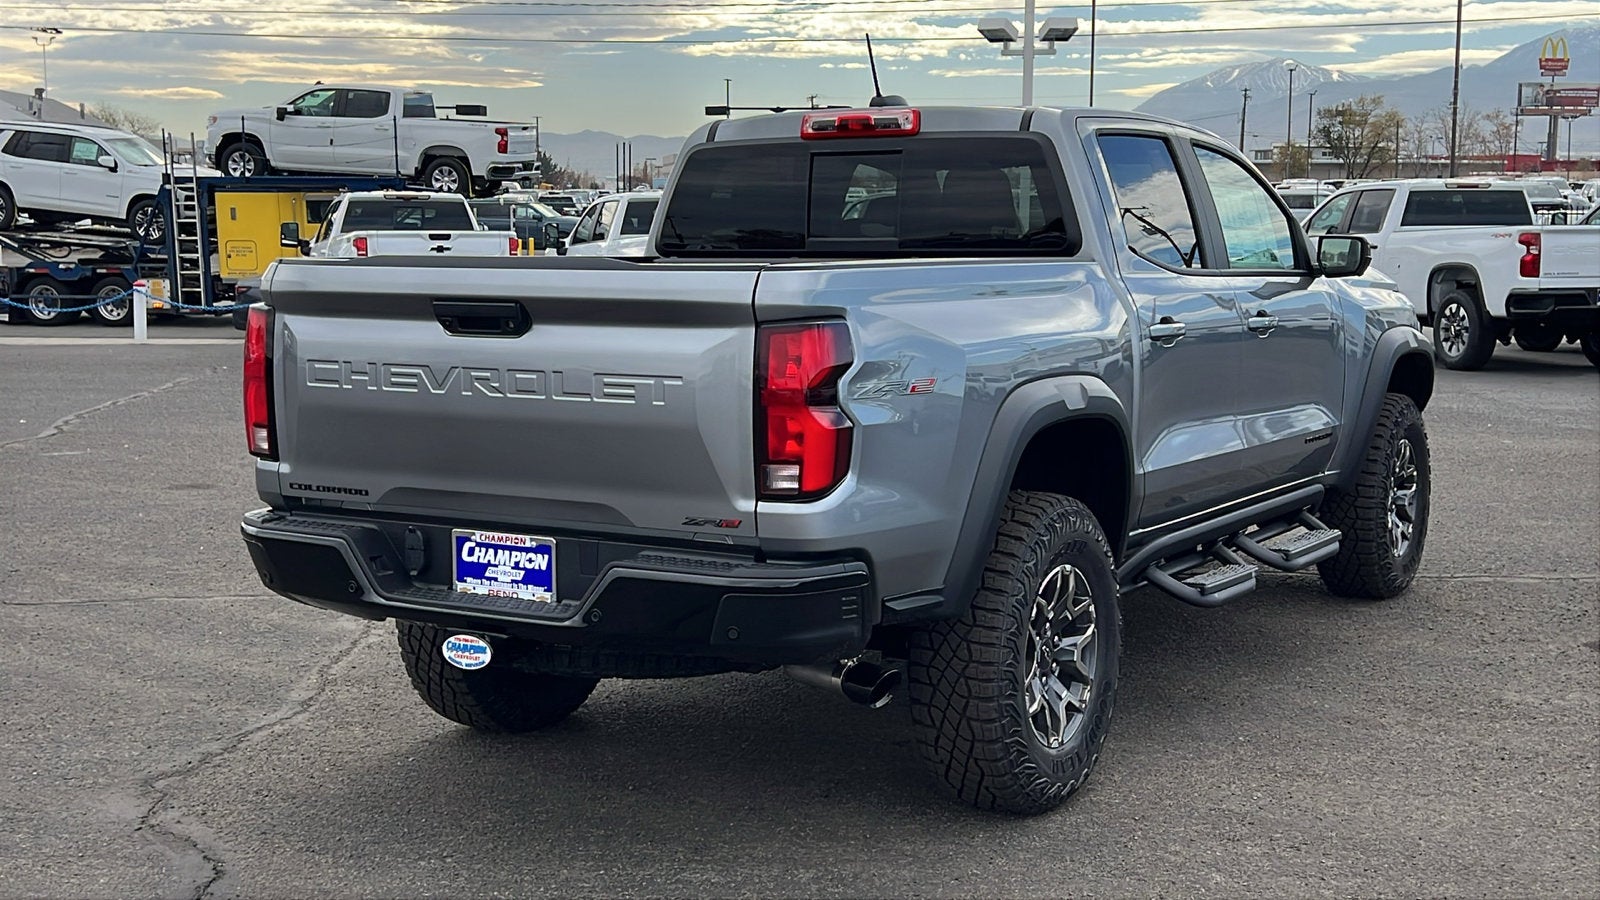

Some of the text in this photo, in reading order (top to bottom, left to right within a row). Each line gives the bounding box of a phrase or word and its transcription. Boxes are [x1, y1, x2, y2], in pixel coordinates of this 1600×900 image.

[306, 359, 684, 405] CHEVROLET
[853, 377, 938, 400] ZR2
[289, 482, 369, 496] COLORADO
[681, 516, 743, 529] ZR2
[479, 533, 527, 546] CHAMPION
[461, 541, 549, 570] CHAMPION
[488, 568, 522, 579] CHEVROLET
[488, 589, 519, 598] RENO
[447, 640, 487, 655] CHAMPION
